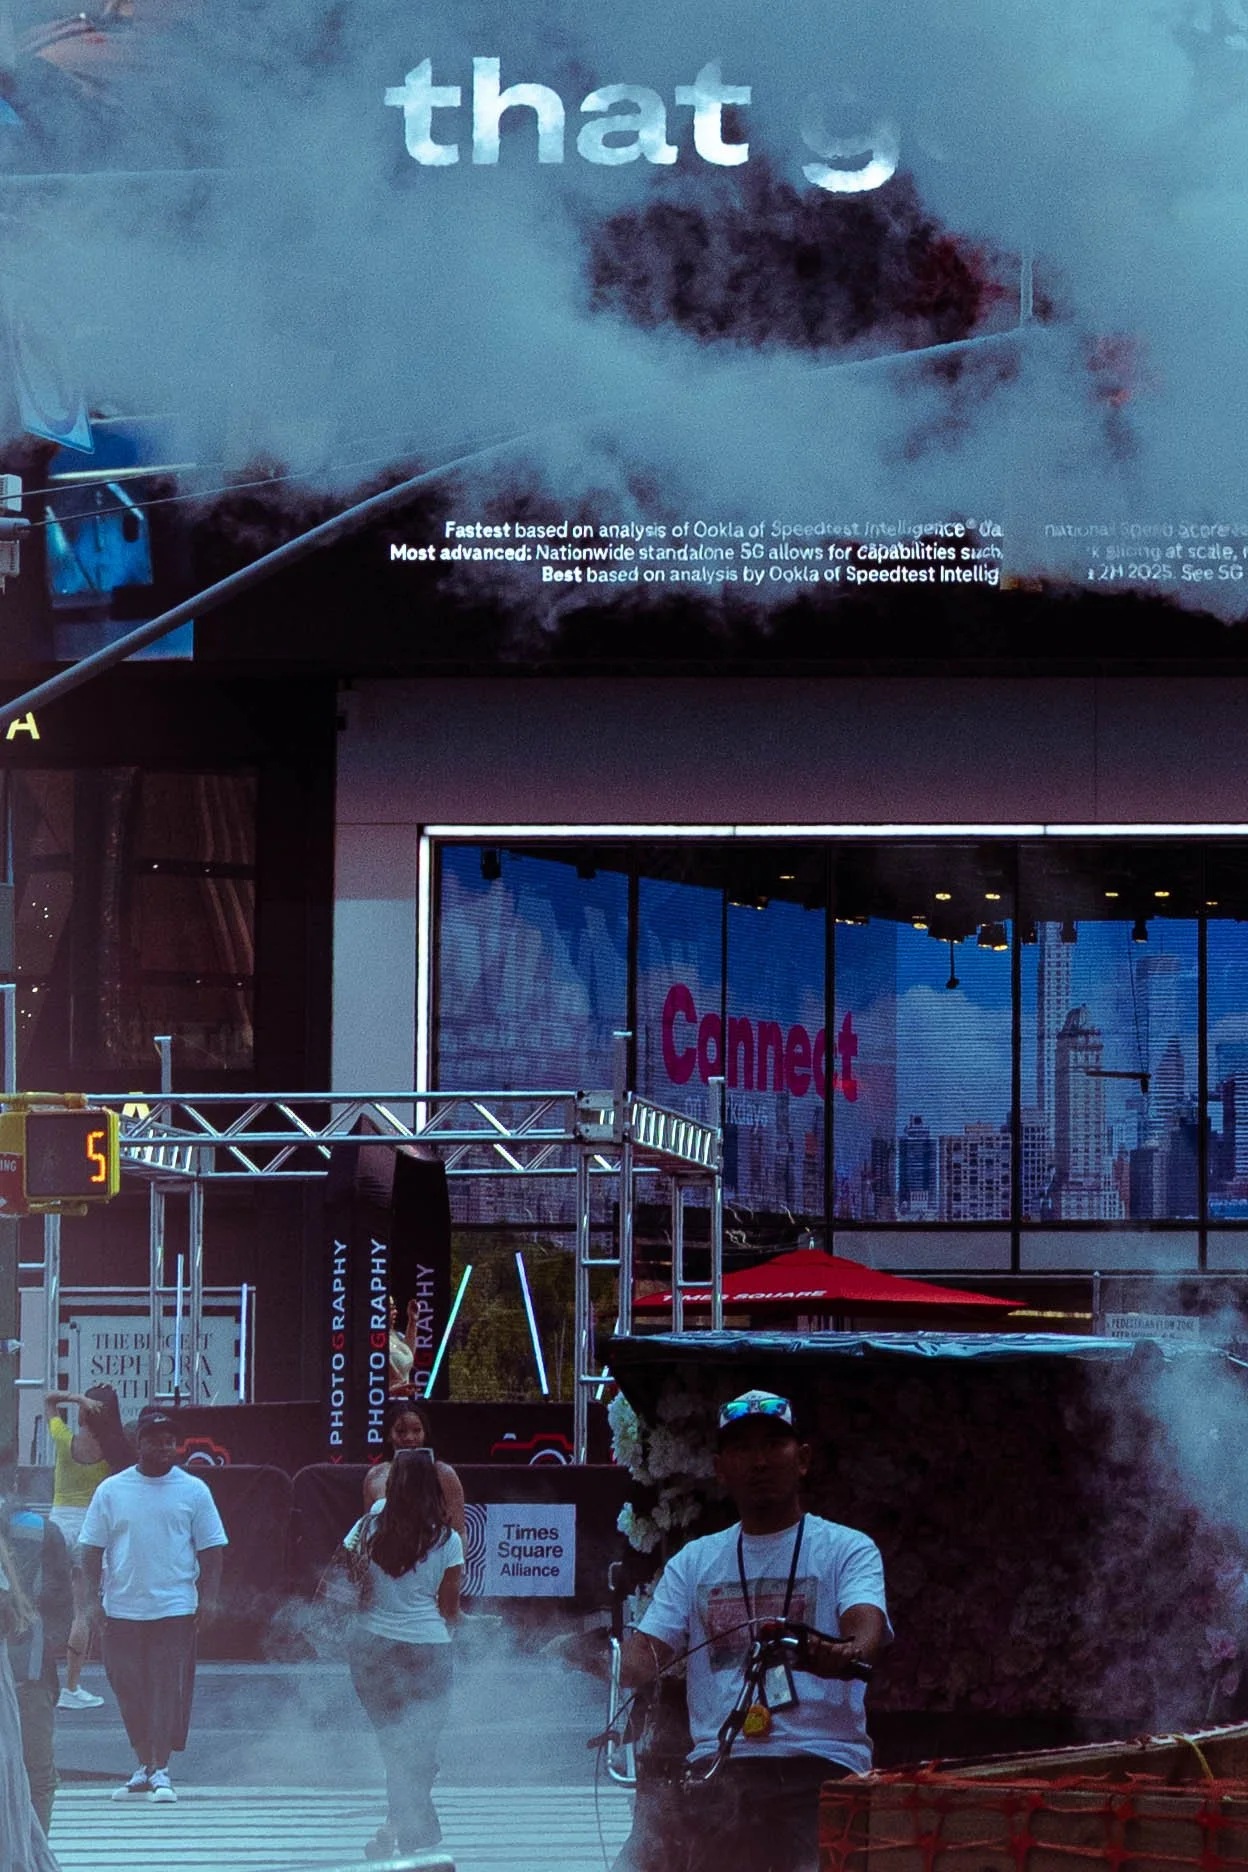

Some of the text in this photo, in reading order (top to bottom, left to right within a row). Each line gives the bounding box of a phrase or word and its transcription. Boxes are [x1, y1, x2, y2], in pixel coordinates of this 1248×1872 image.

[384, 57, 752, 167] that
[445, 521, 511, 538] Fastest
[515, 521, 568, 538] based
[572, 526, 593, 538] on
[599, 522, 666, 541] analysis
[672, 521, 688, 538] of
[693, 521, 744, 538] Ookla
[749, 521, 765, 538] of
[390, 543, 435, 561] Most
[440, 543, 532, 561] advanced:
[536, 543, 635, 561] Nationwide
[639, 543, 734, 560] standalone
[740, 543, 764, 560] 5G
[769, 543, 823, 560] allows
[829, 543, 852, 560] for
[857, 542, 956, 564] capabilities
[1166, 543, 1182, 559] at
[542, 565, 1000, 585] Best based on analysis by Ookla of Speedtest Intellig
[662, 983, 858, 1104] Connect
[86, 1131, 106, 1182] 5
[733, 1290, 827, 1300] SQUARE
[93, 1333, 129, 1350] THE
[330, 1240, 347, 1445] PHOTOGRAPHY
[367, 1239, 387, 1443] PHOTOGRAPHY
[503, 1523, 559, 1540] Times
[497, 1541, 563, 1561] Square
[500, 1563, 560, 1577] Alliance
